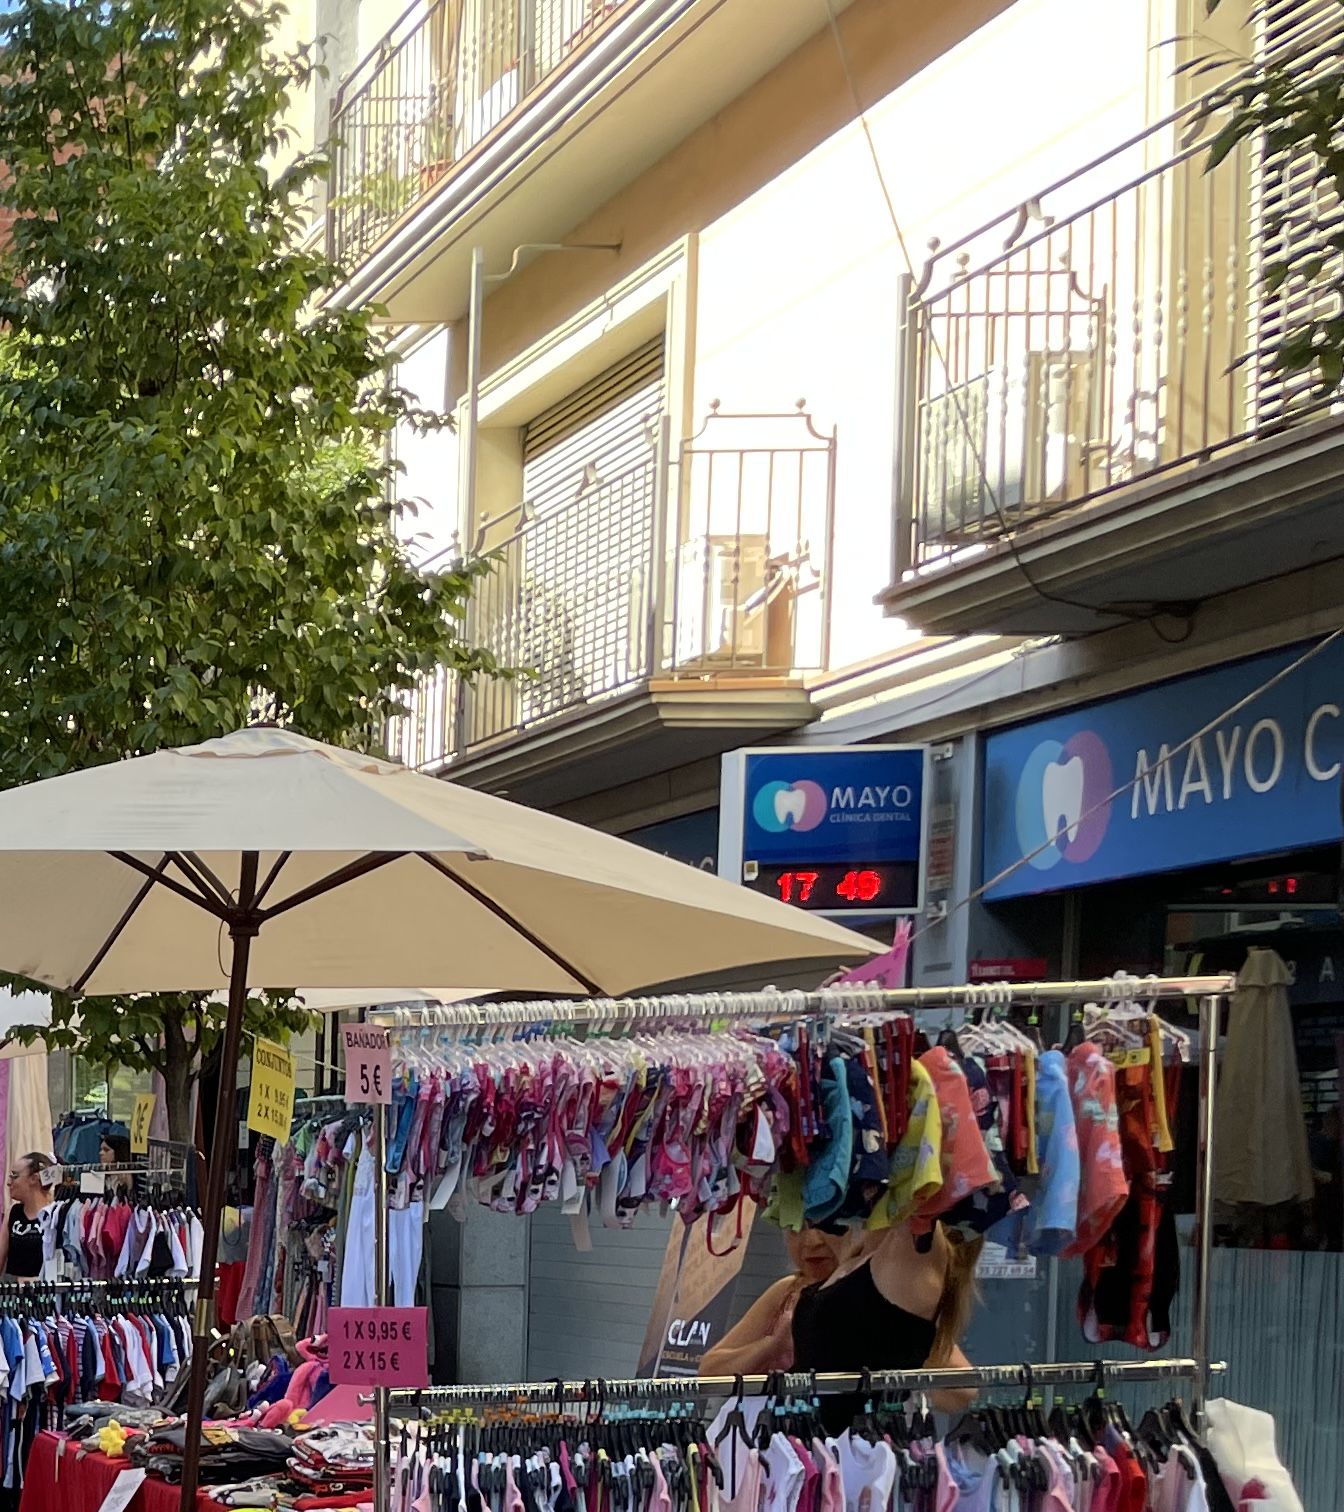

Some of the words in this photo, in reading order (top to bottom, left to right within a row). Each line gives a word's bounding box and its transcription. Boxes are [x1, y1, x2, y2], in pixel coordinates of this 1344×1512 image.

[1131, 718, 1284, 819] MAYO
[830, 785, 911, 808] MAYO
[829, 812, 872, 823] CLÍNICA
[873, 811, 912, 822] DENTAL
[777, 872, 819, 901] 17
[360, 1063, 370, 1095] 5
[373, 1063, 383, 1097] €
[354, 1321, 364, 1340] X
[368, 1321, 398, 1343] 9,95
[402, 1321, 411, 1341] €
[668, 1318, 711, 1347] CLAN
[343, 1351, 351, 1369] 2
[355, 1351, 365, 1370] X
[369, 1352, 387, 1371] 15
[390, 1352, 400, 1371] €
